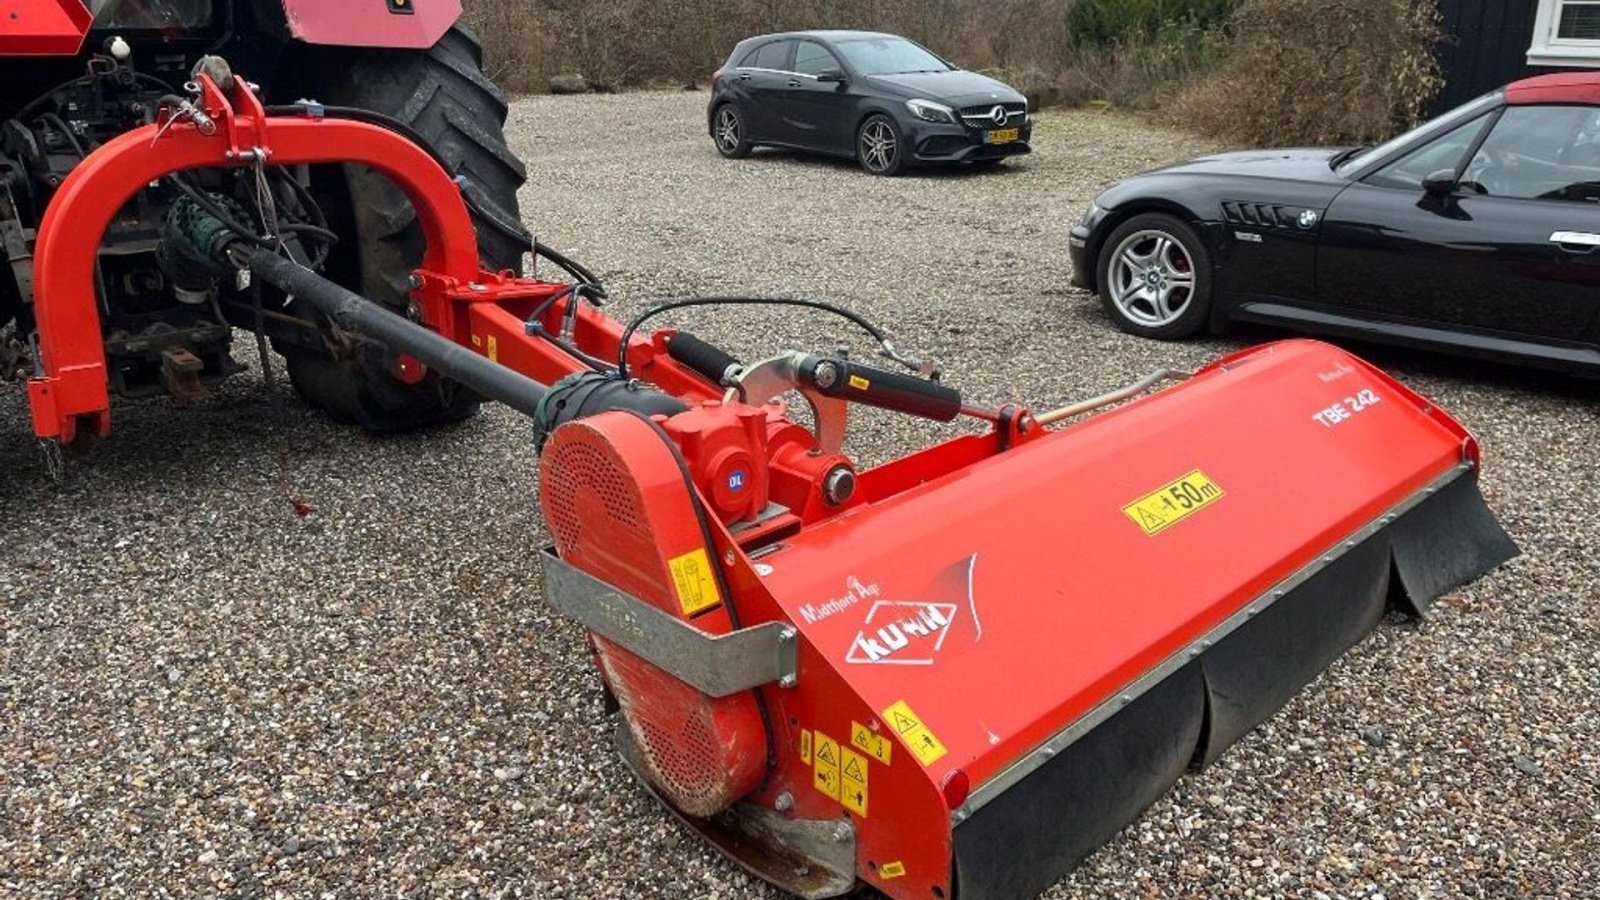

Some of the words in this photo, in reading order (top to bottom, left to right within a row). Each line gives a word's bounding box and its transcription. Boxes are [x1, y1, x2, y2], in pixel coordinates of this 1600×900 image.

[1312, 403, 1351, 428] TBE
[1343, 388, 1381, 412] 242
[729, 474, 742, 488] OIL
